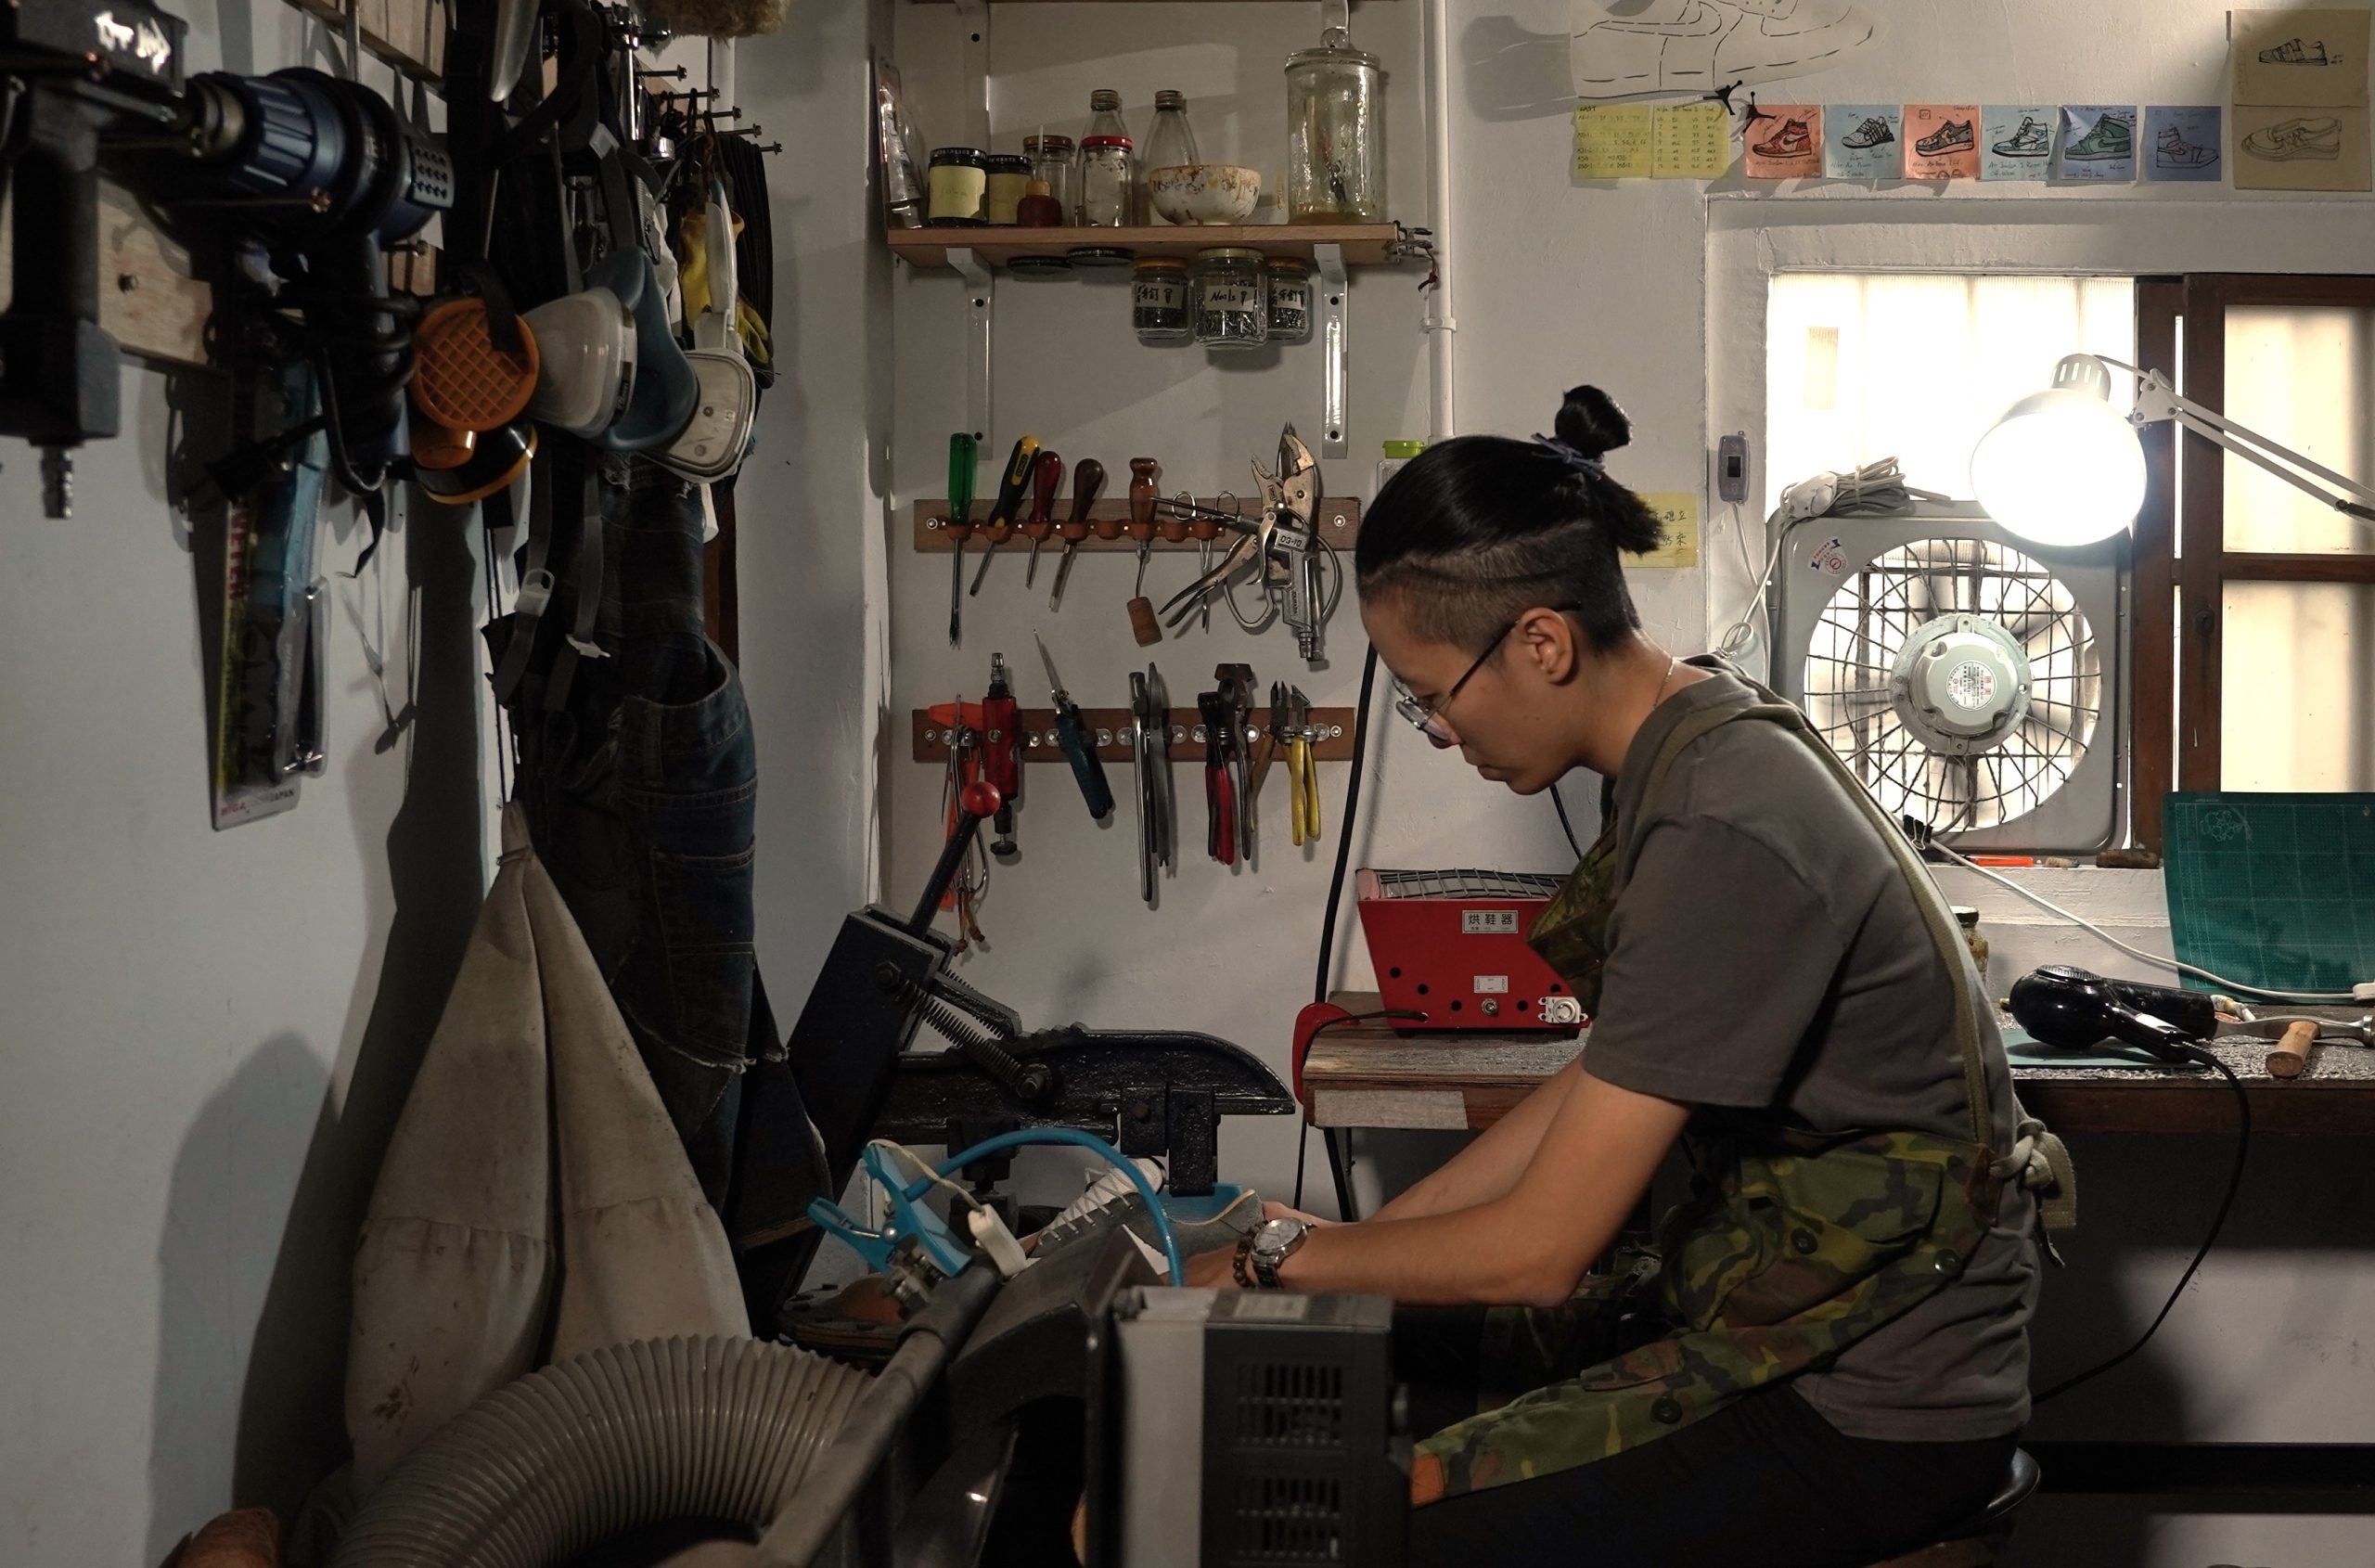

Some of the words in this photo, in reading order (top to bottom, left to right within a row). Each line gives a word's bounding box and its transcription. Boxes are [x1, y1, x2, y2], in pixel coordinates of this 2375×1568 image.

[1210, 289, 1236, 302] Nails
[1468, 913, 1513, 925] 烘鞋器
